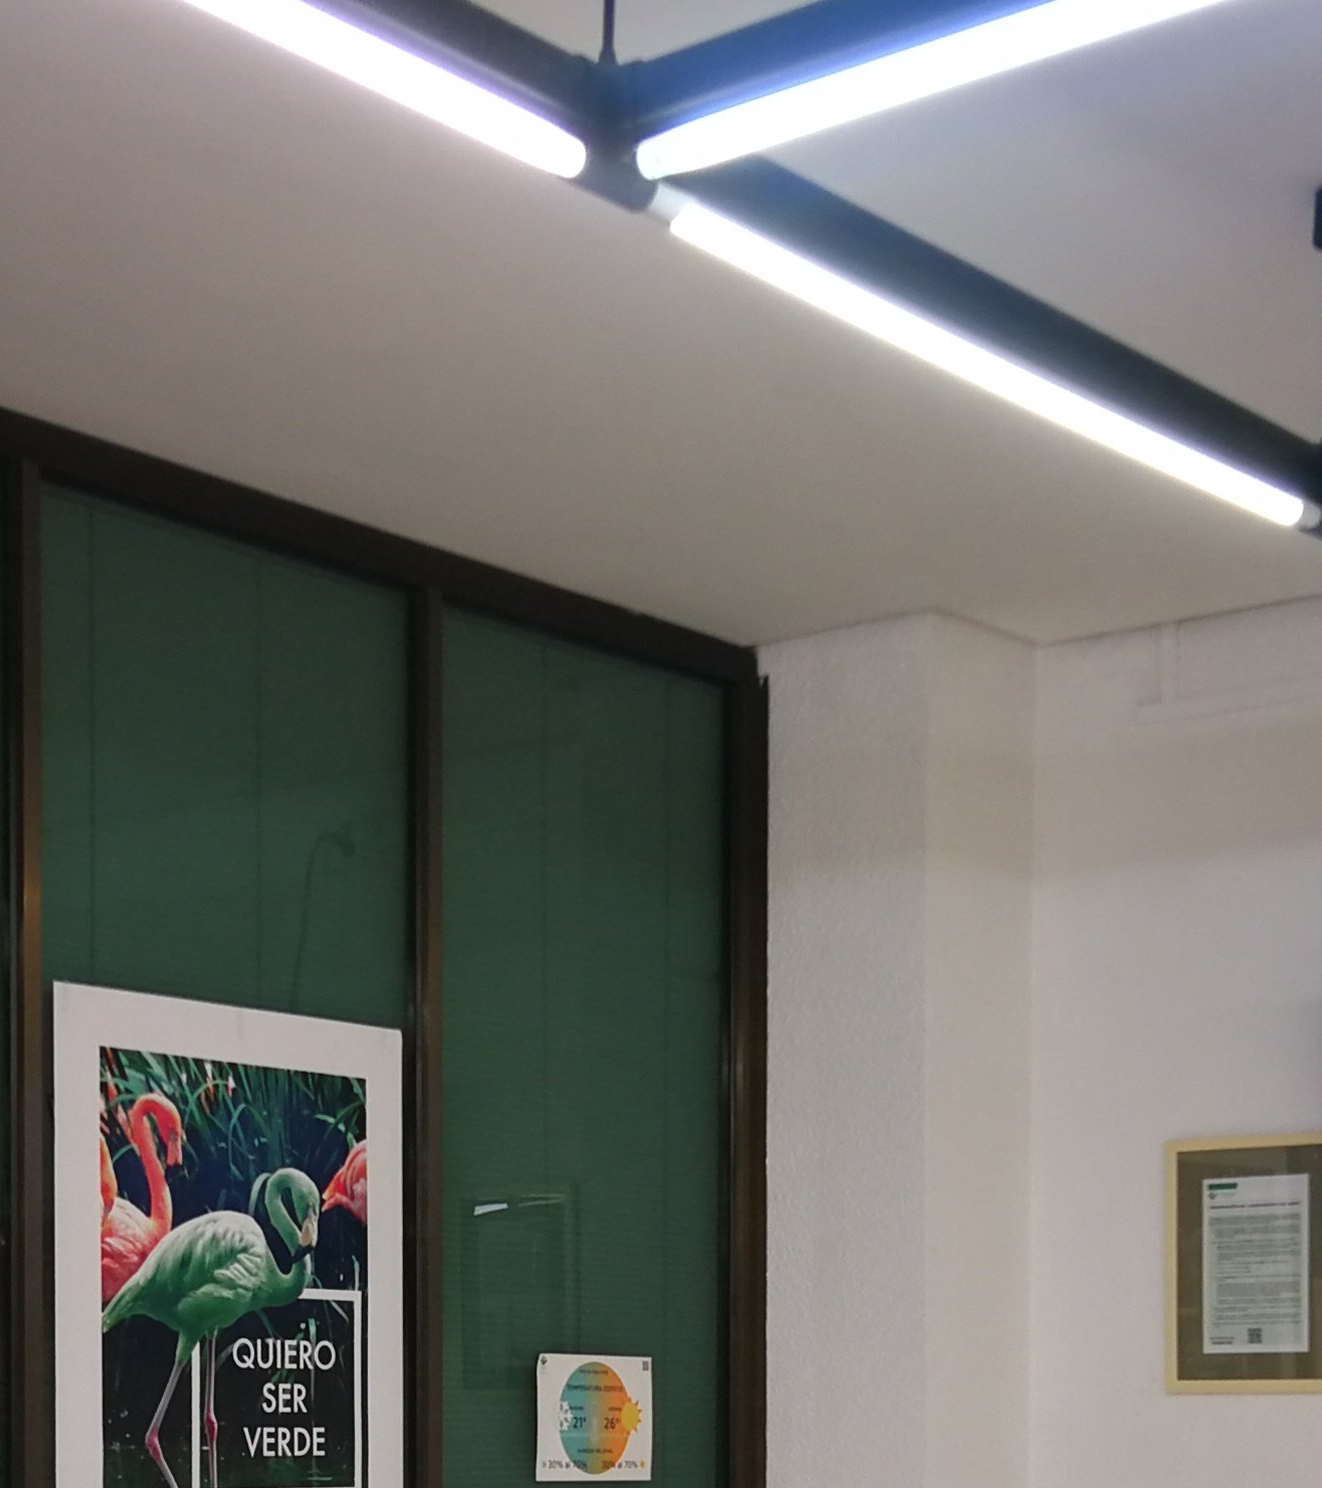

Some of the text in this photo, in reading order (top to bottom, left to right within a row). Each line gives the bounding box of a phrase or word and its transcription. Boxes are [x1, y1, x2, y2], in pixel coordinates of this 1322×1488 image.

[232, 1337, 336, 1370] QUIERO
[262, 1382, 308, 1413] SER
[243, 1427, 326, 1458] VERDE
